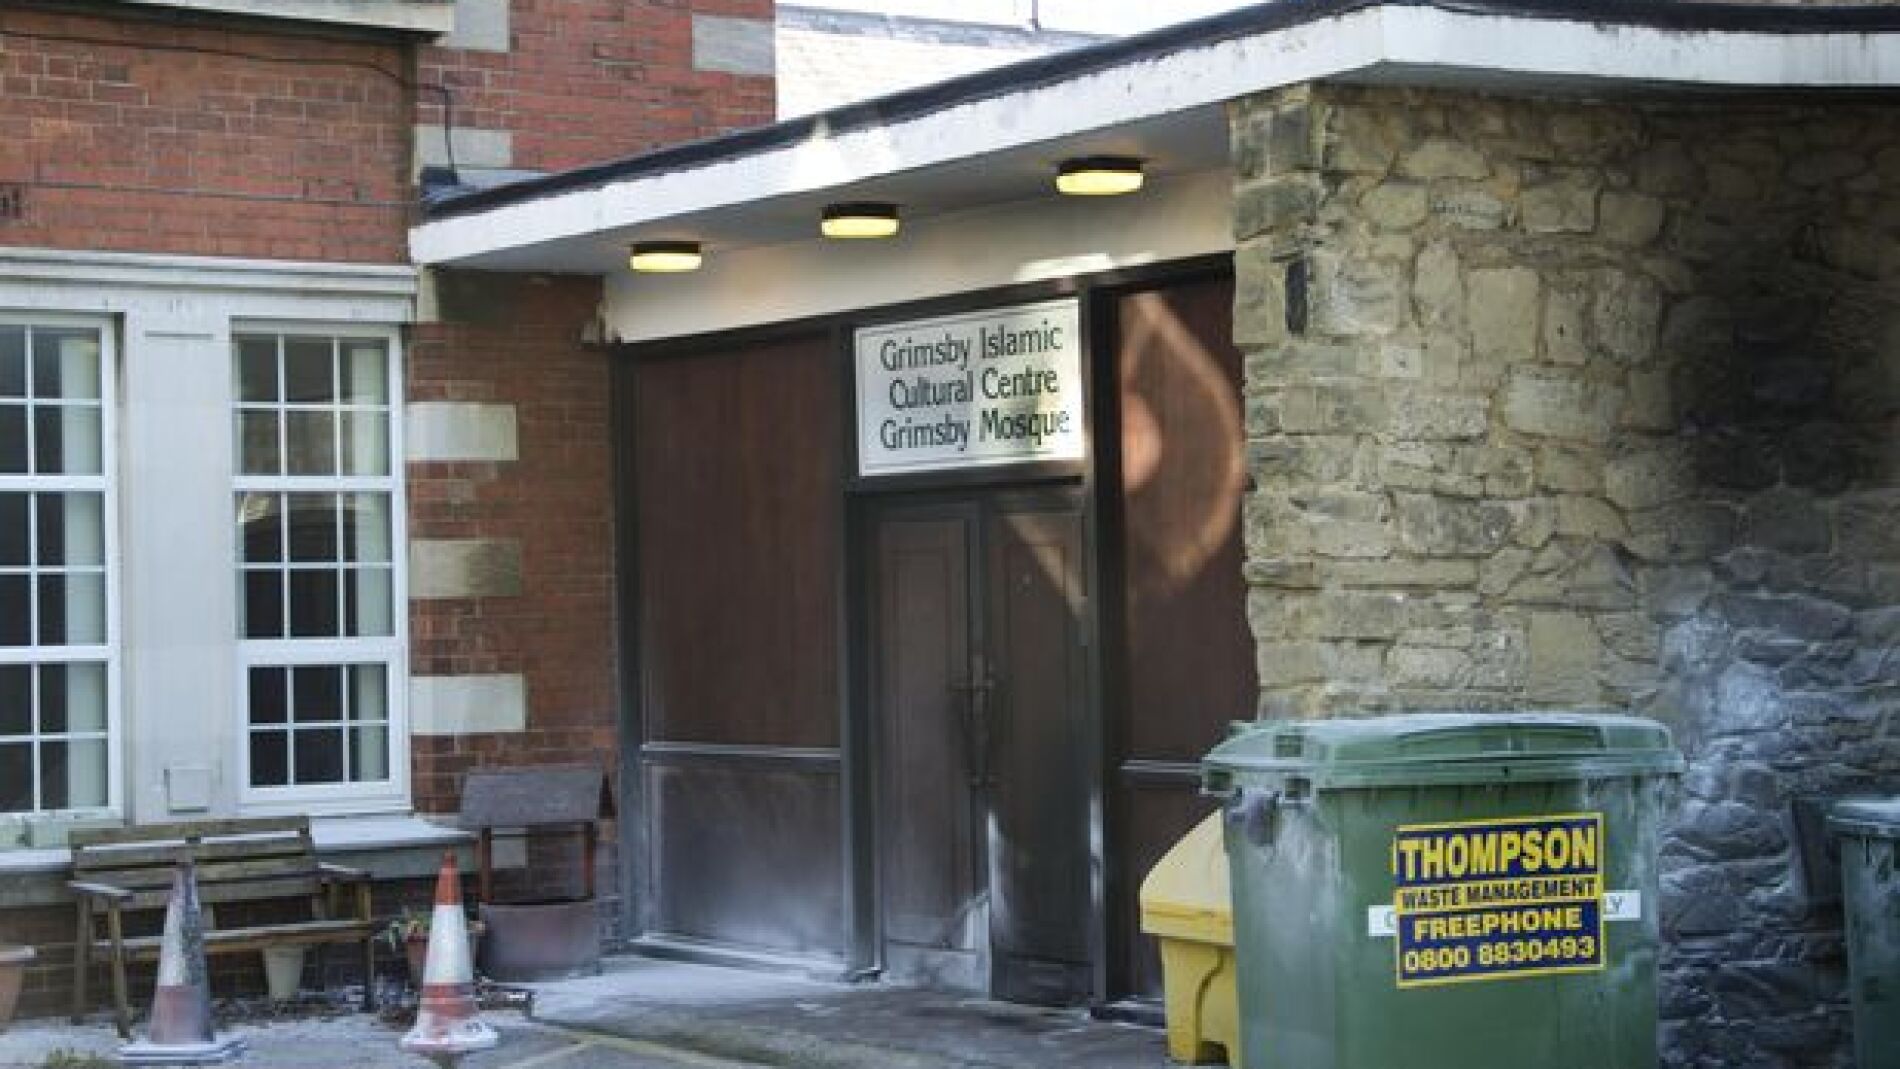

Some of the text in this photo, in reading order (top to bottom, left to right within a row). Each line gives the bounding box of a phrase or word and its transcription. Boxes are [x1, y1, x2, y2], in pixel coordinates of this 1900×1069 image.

[880, 318, 1063, 371] Grimsby Islamic
[889, 364, 1060, 411] Cultural Centre
[880, 407, 1071, 452] Grimsby Mosque
[1400, 826, 1596, 880] THOMPSON
[1402, 878, 1597, 909] WASTE MANAGEMENT
[1414, 907, 1583, 942] FREEPHONE
[1405, 945, 1471, 973] 0800
